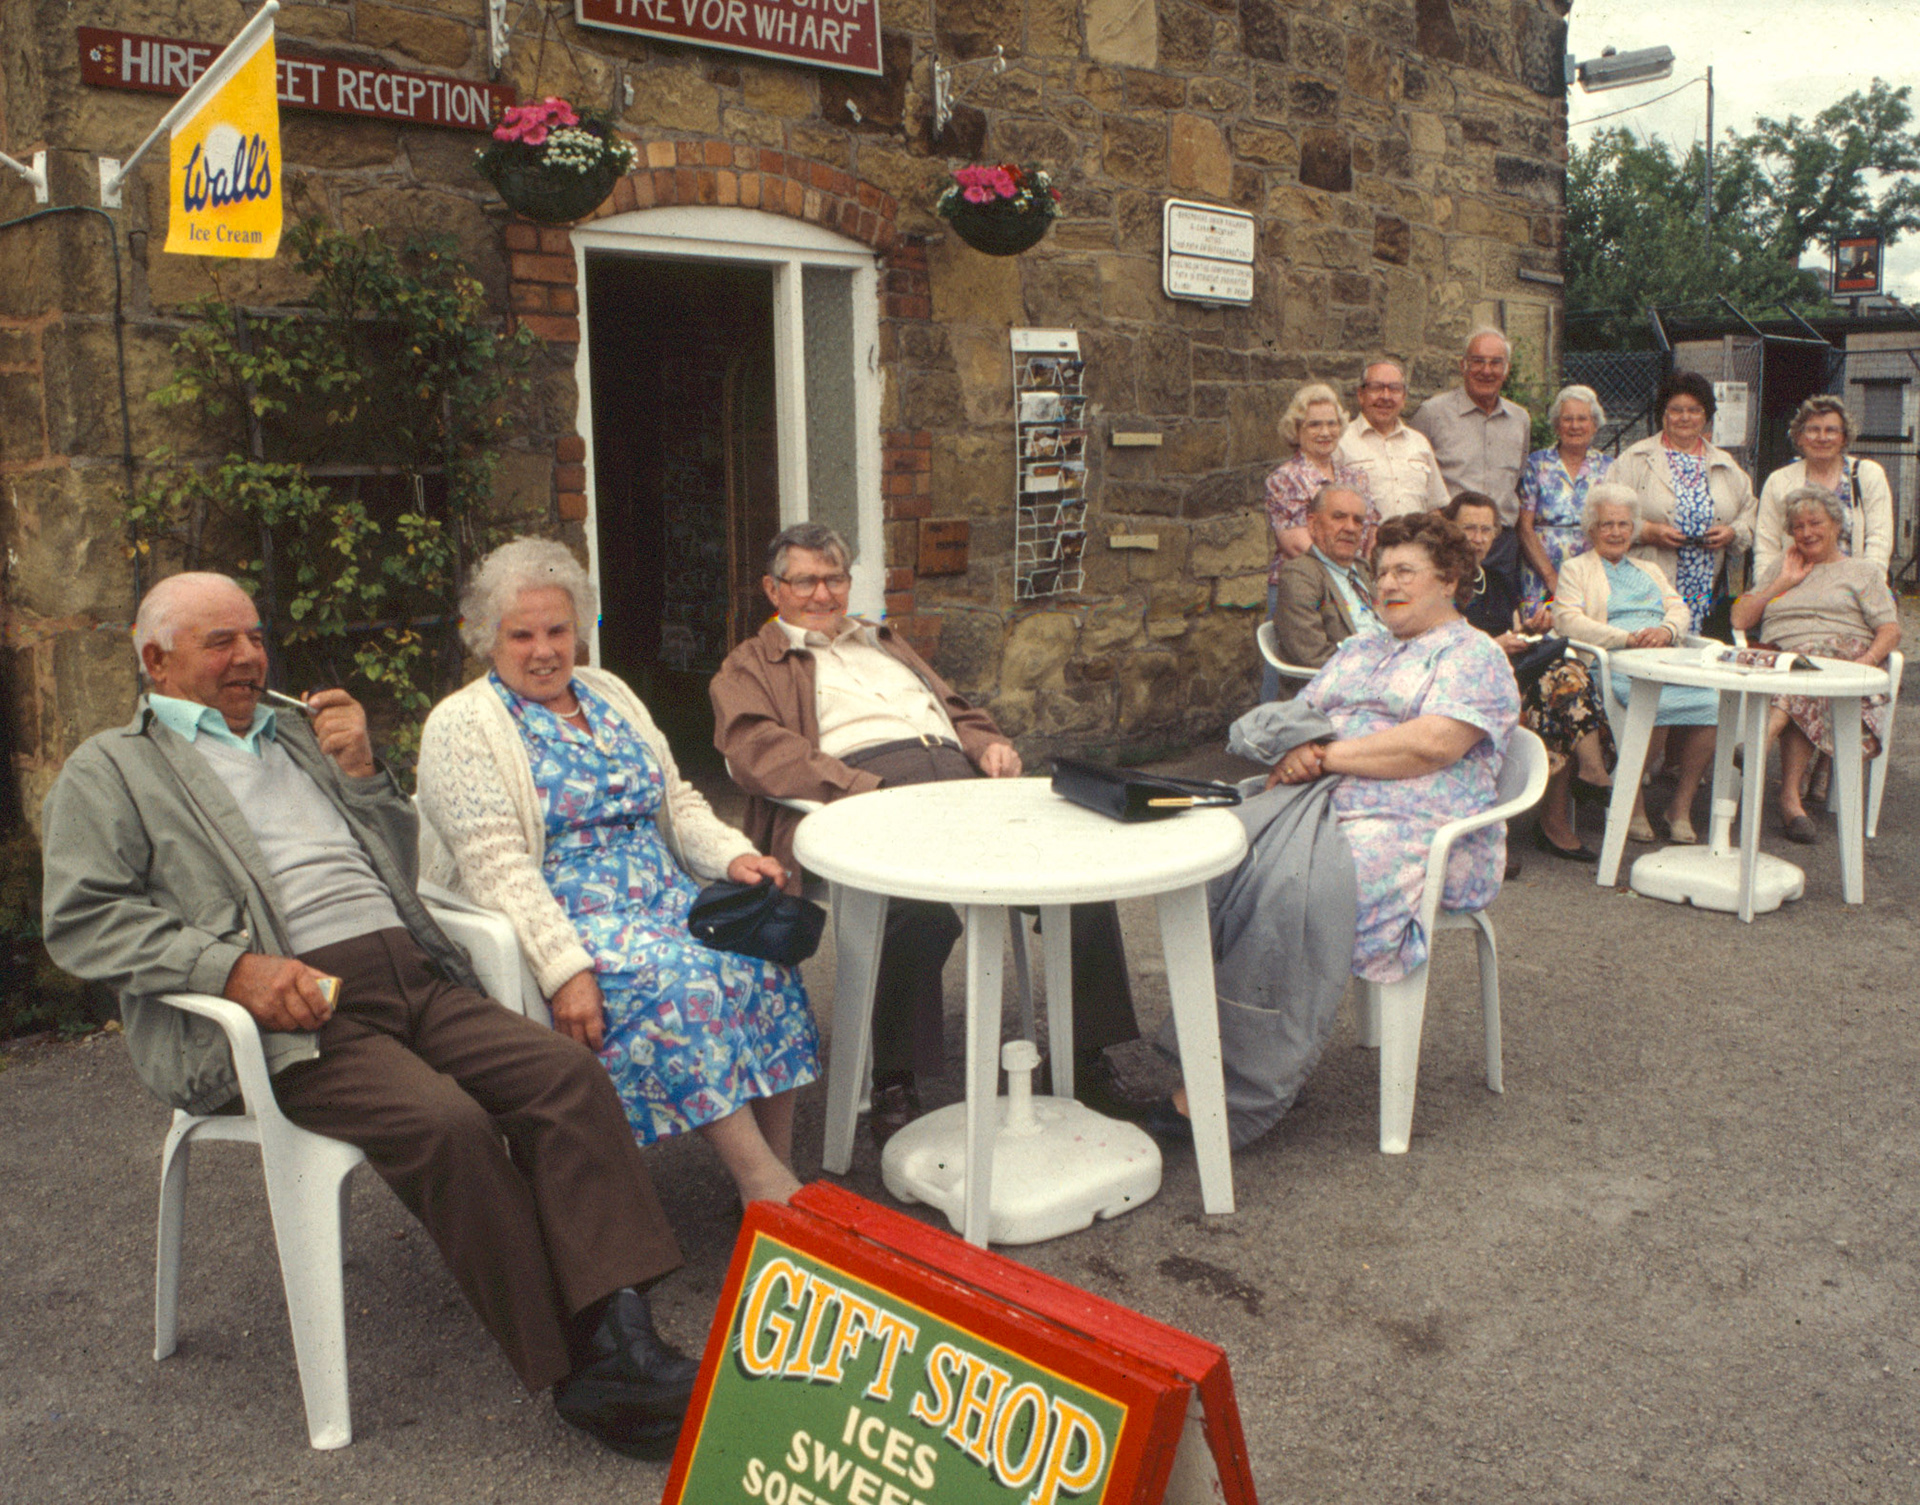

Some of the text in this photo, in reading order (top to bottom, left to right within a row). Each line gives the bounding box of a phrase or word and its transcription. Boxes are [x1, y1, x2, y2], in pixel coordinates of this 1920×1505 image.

[753, 4, 861, 54] WHARF
[121, 38, 491, 125] HIRE EET RECEPTION
[182, 133, 272, 213] Wall's
[189, 223, 263, 244] Ice Cream
[738, 1257, 1107, 1505] GIFT SHOP
[742, 1457, 833, 1505] SOF
[785, 1430, 932, 1505] SWEE
[842, 1405, 938, 1489] ICES
